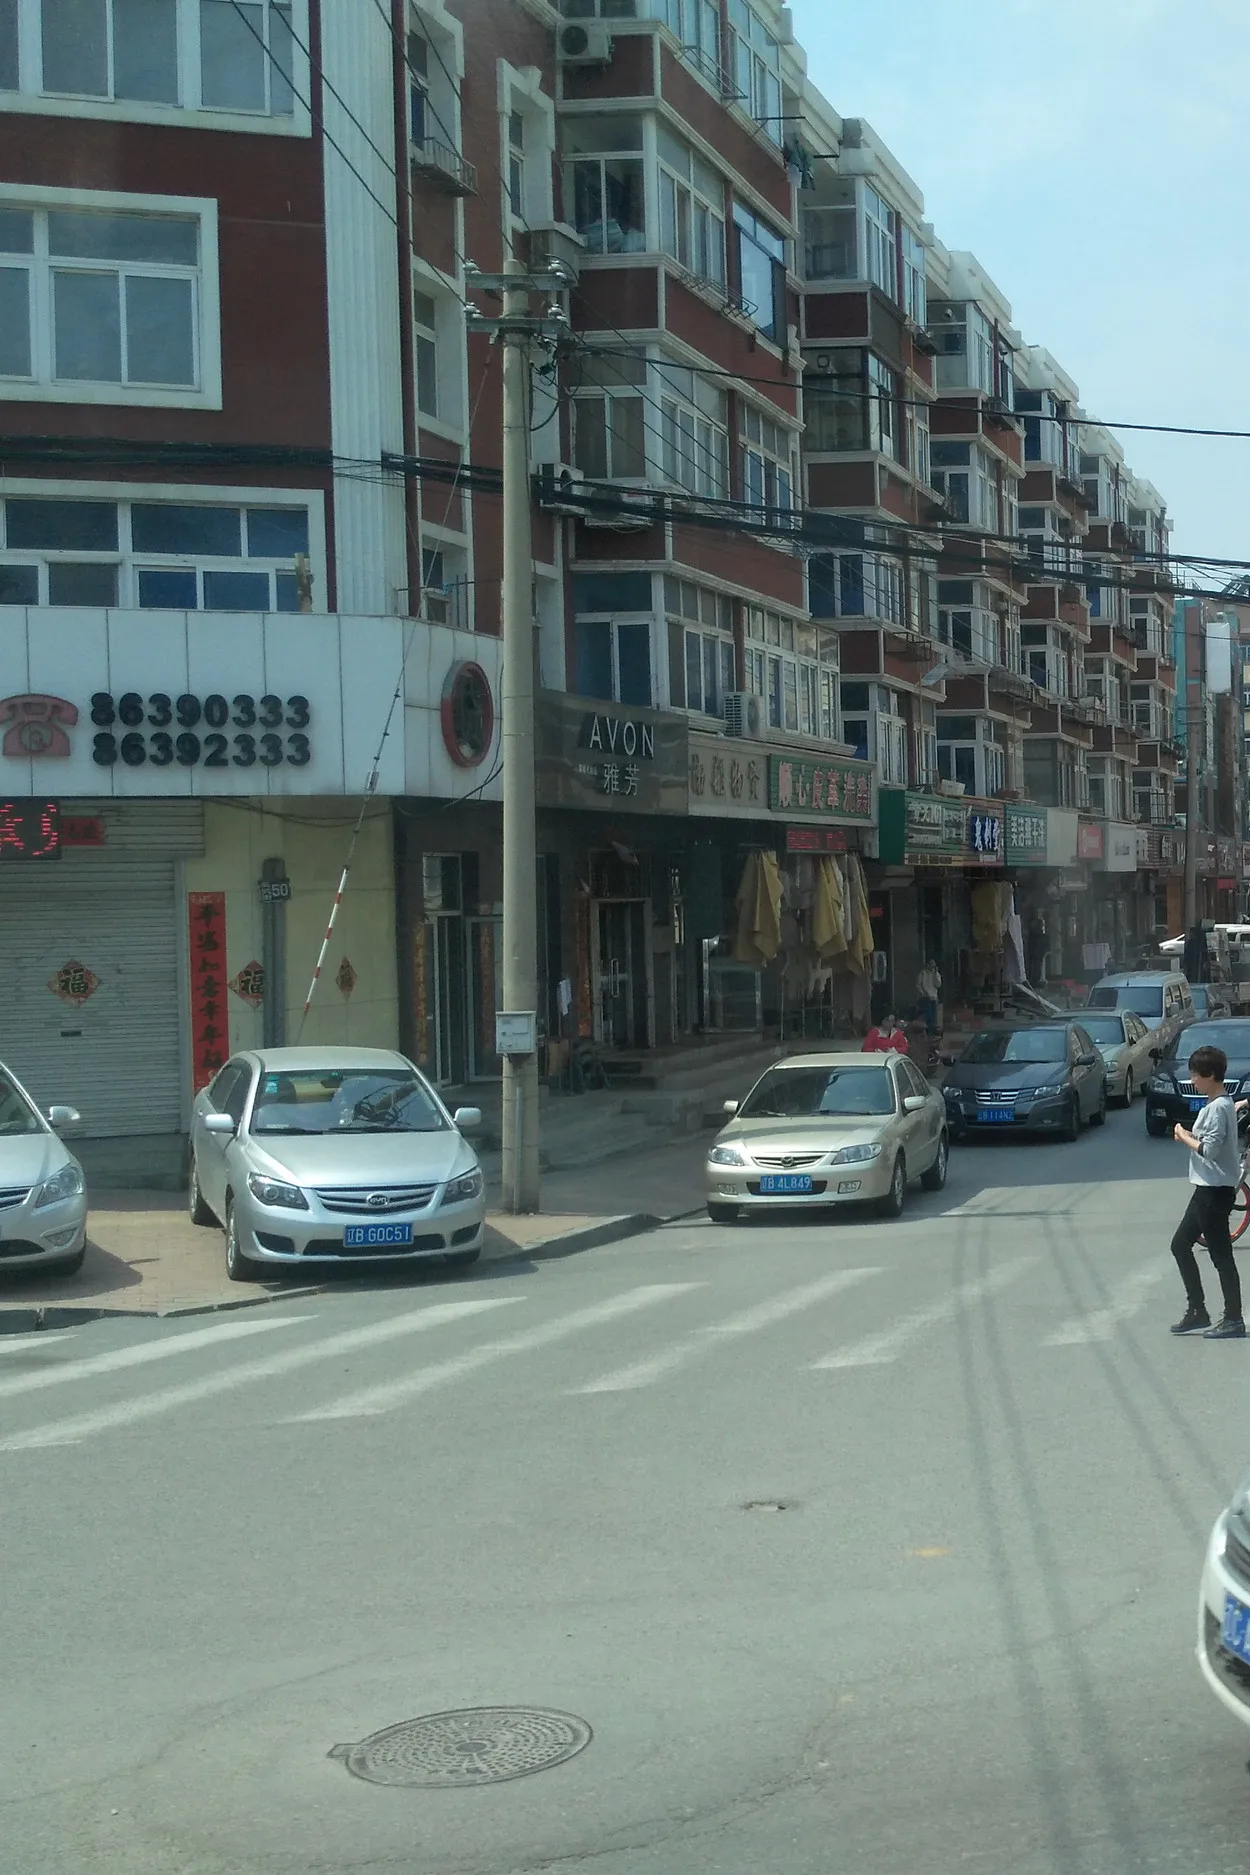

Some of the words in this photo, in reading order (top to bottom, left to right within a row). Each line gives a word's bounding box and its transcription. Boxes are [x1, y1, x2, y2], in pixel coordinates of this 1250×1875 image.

[91, 692, 310, 728] 86390333
[93, 732, 310, 766] 86392333
[590, 715, 654, 757] AVON
[604, 763, 639, 796] 雅芳
[272, 884, 289, 896] 50
[59, 968, 89, 995] 福
